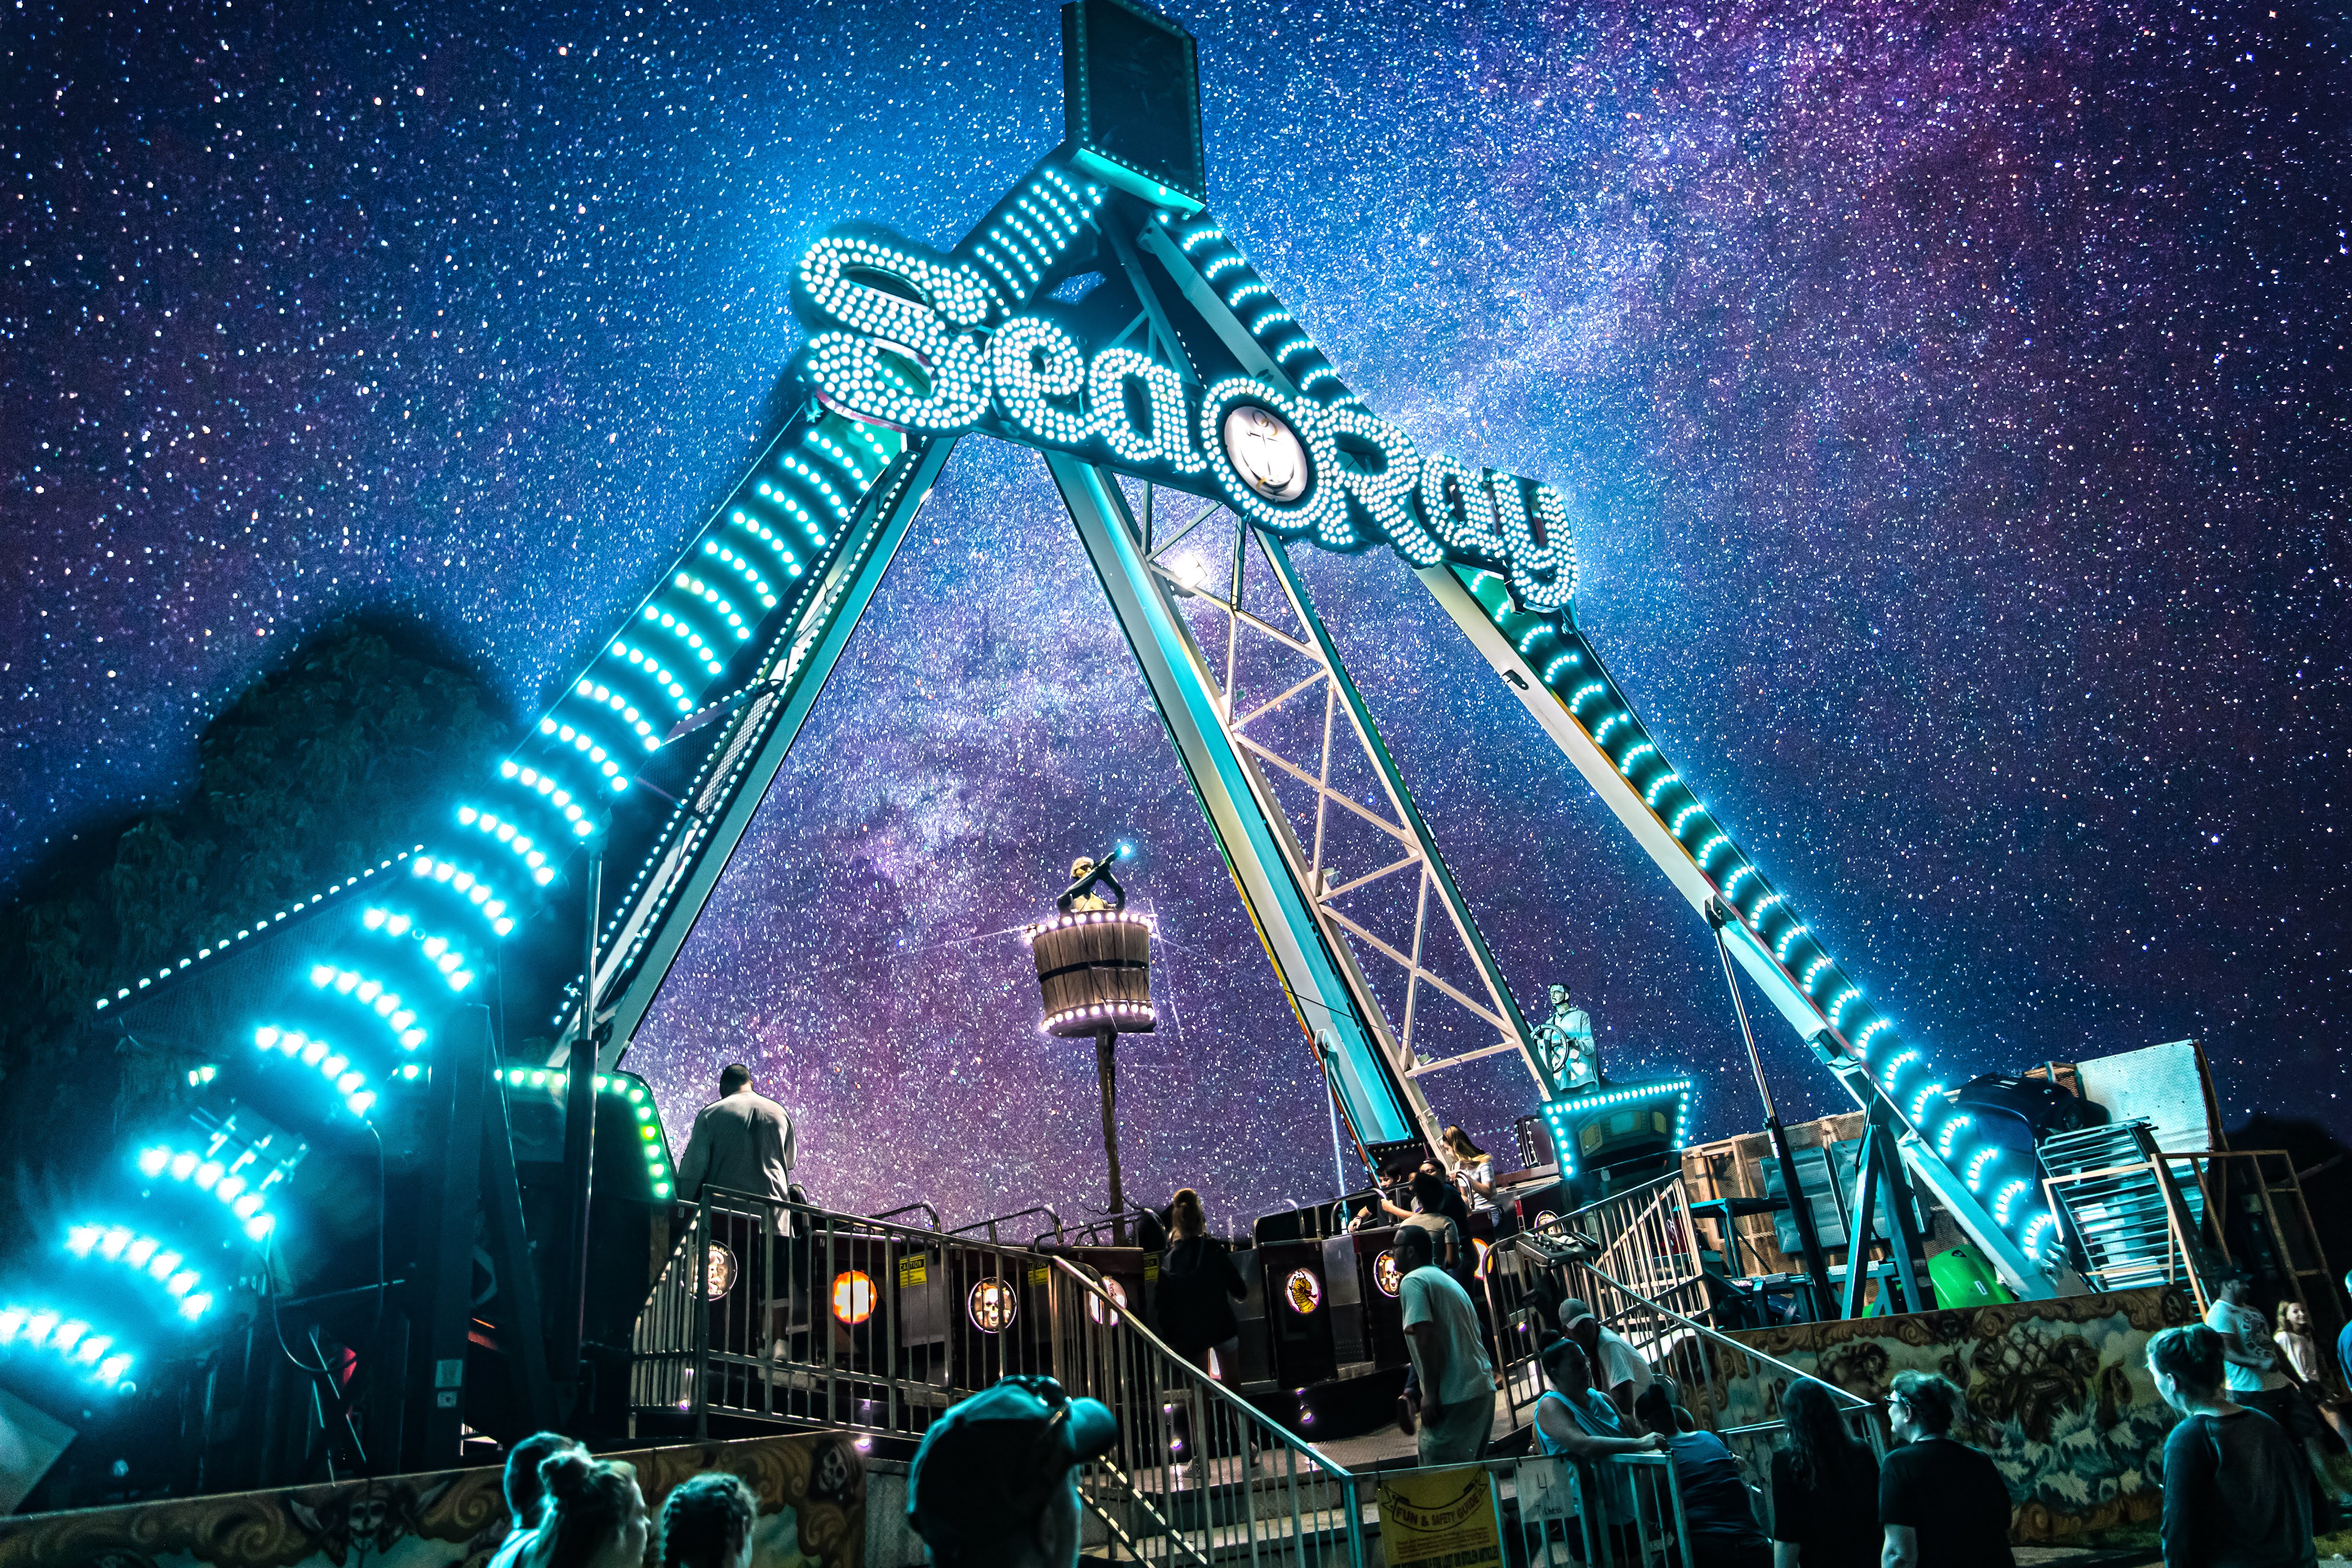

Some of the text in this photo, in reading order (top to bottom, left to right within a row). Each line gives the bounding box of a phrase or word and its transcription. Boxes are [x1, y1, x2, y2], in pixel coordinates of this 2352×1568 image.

[800, 236, 1579, 610] Sea Ray
[1537, 1472, 1550, 1500] 4
[1396, 1494, 1480, 1527] FUN & SAFETY GUIDE
